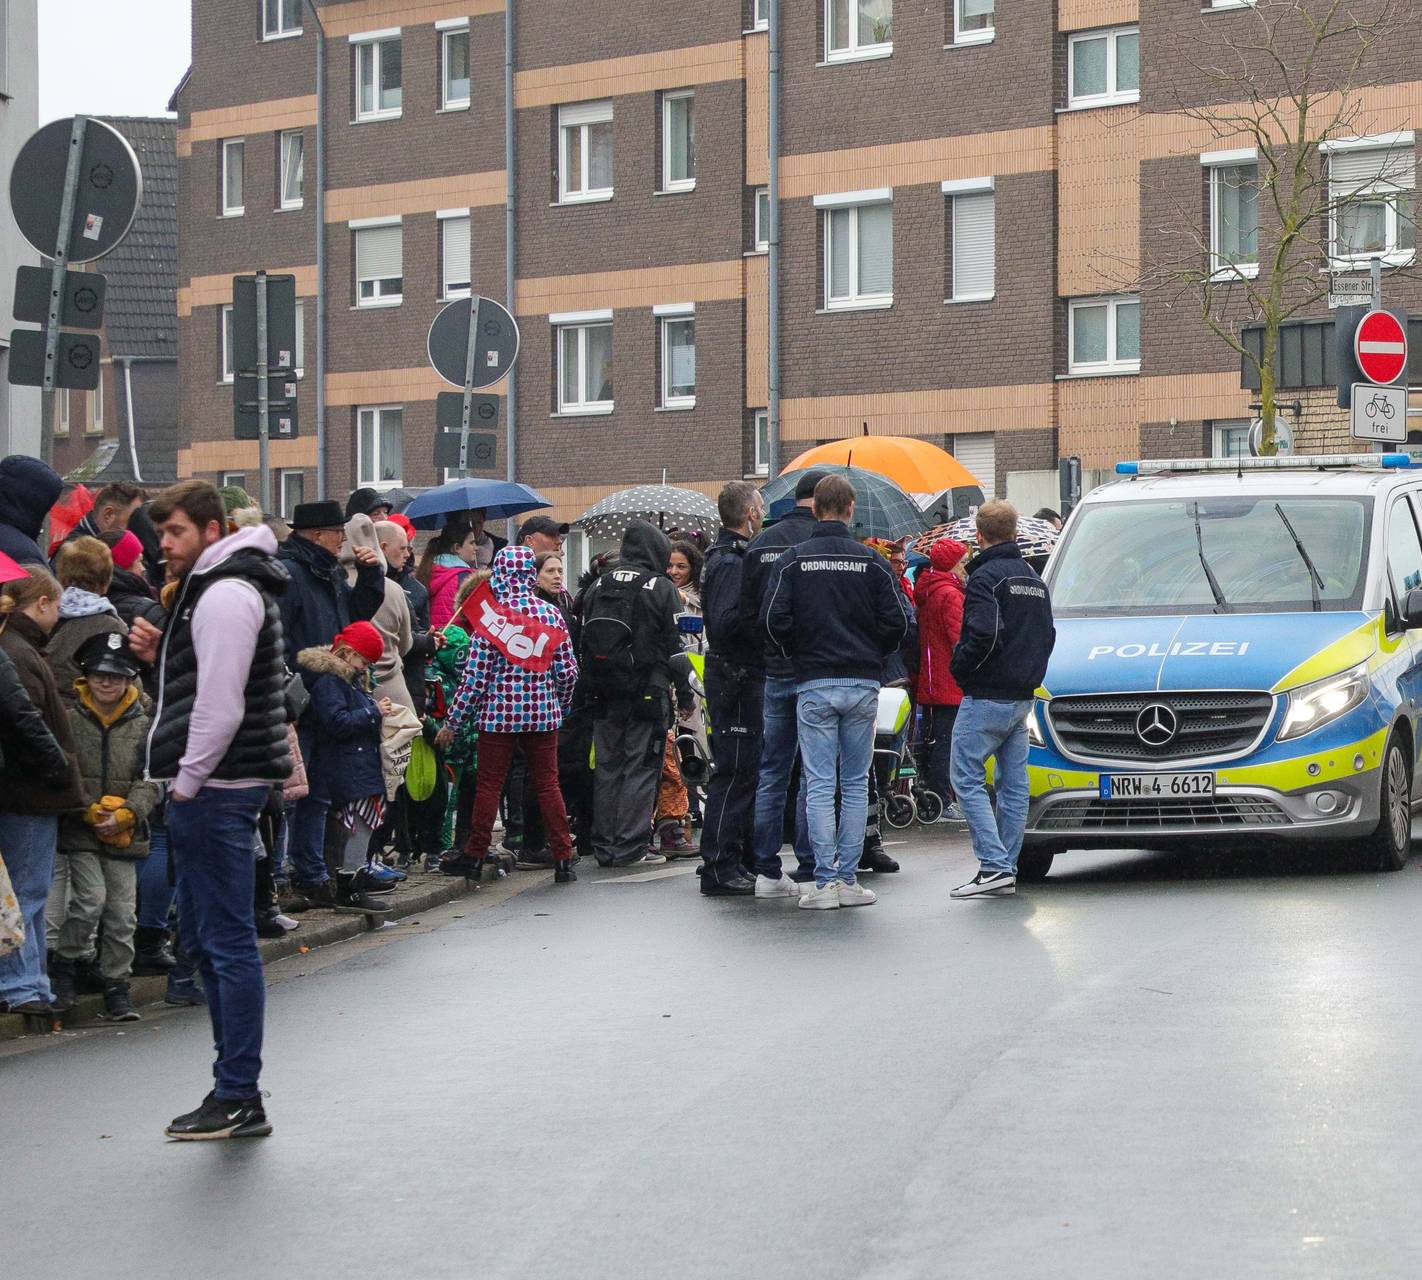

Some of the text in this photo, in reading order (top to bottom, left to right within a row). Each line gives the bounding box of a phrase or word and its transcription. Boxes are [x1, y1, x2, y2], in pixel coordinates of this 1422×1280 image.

[1333, 280, 1358, 292] Essener
[1372, 421, 1389, 433] frei
[800, 560, 868, 573] ORDNUNGSAMT
[1087, 641, 1250, 661] POLIZEI
[1111, 778, 1142, 796] NRW
